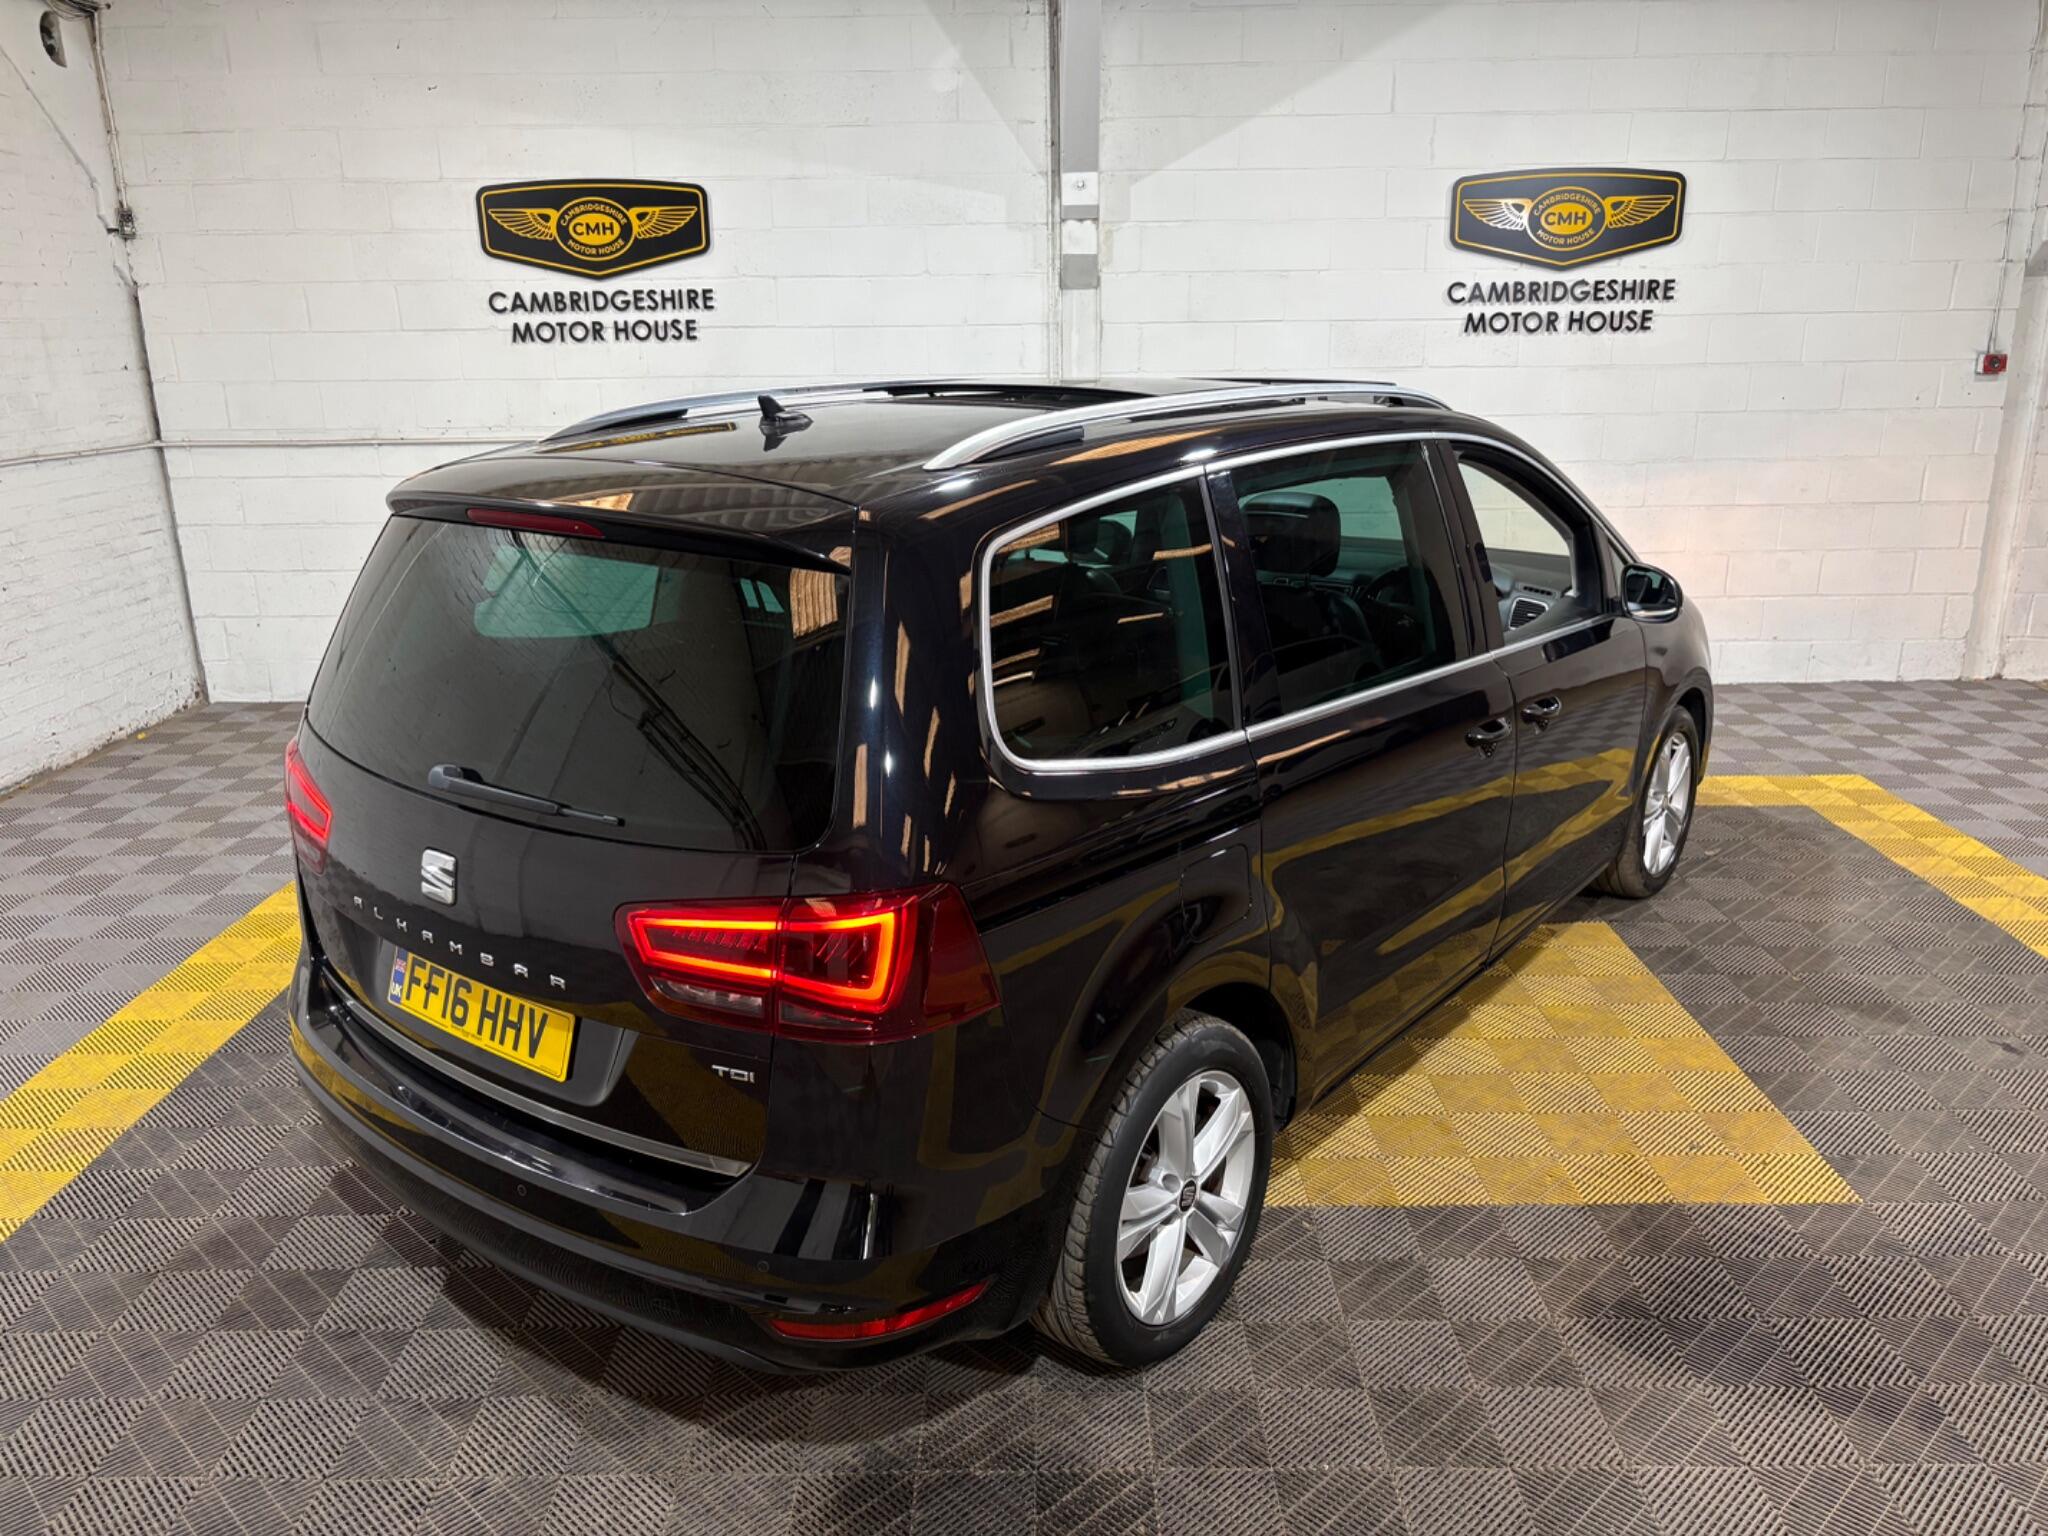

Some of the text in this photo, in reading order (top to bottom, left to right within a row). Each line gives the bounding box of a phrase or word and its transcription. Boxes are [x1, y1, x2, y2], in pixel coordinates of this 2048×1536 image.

[560, 203, 628, 226] CAMBRIDGESHIRE
[1544, 210, 1588, 226] CMH
[572, 221, 615, 236] CMH
[1536, 227, 1595, 245] MOTOR HOUSE
[567, 238, 625, 255] MOTOR HOUSE
[488, 288, 716, 314] CAMBRIDGESHIRE
[1447, 278, 1677, 304] CAMBRIDGESHIRE
[511, 318, 699, 344] MOTOR HOUSE
[1463, 309, 1654, 334] MOTOR HOUSE
[353, 895, 566, 991] ALHAMBRA
[390, 981, 402, 998] UK
[405, 954, 549, 1060] FF16 HHV
[711, 1064, 756, 1084] TDI
